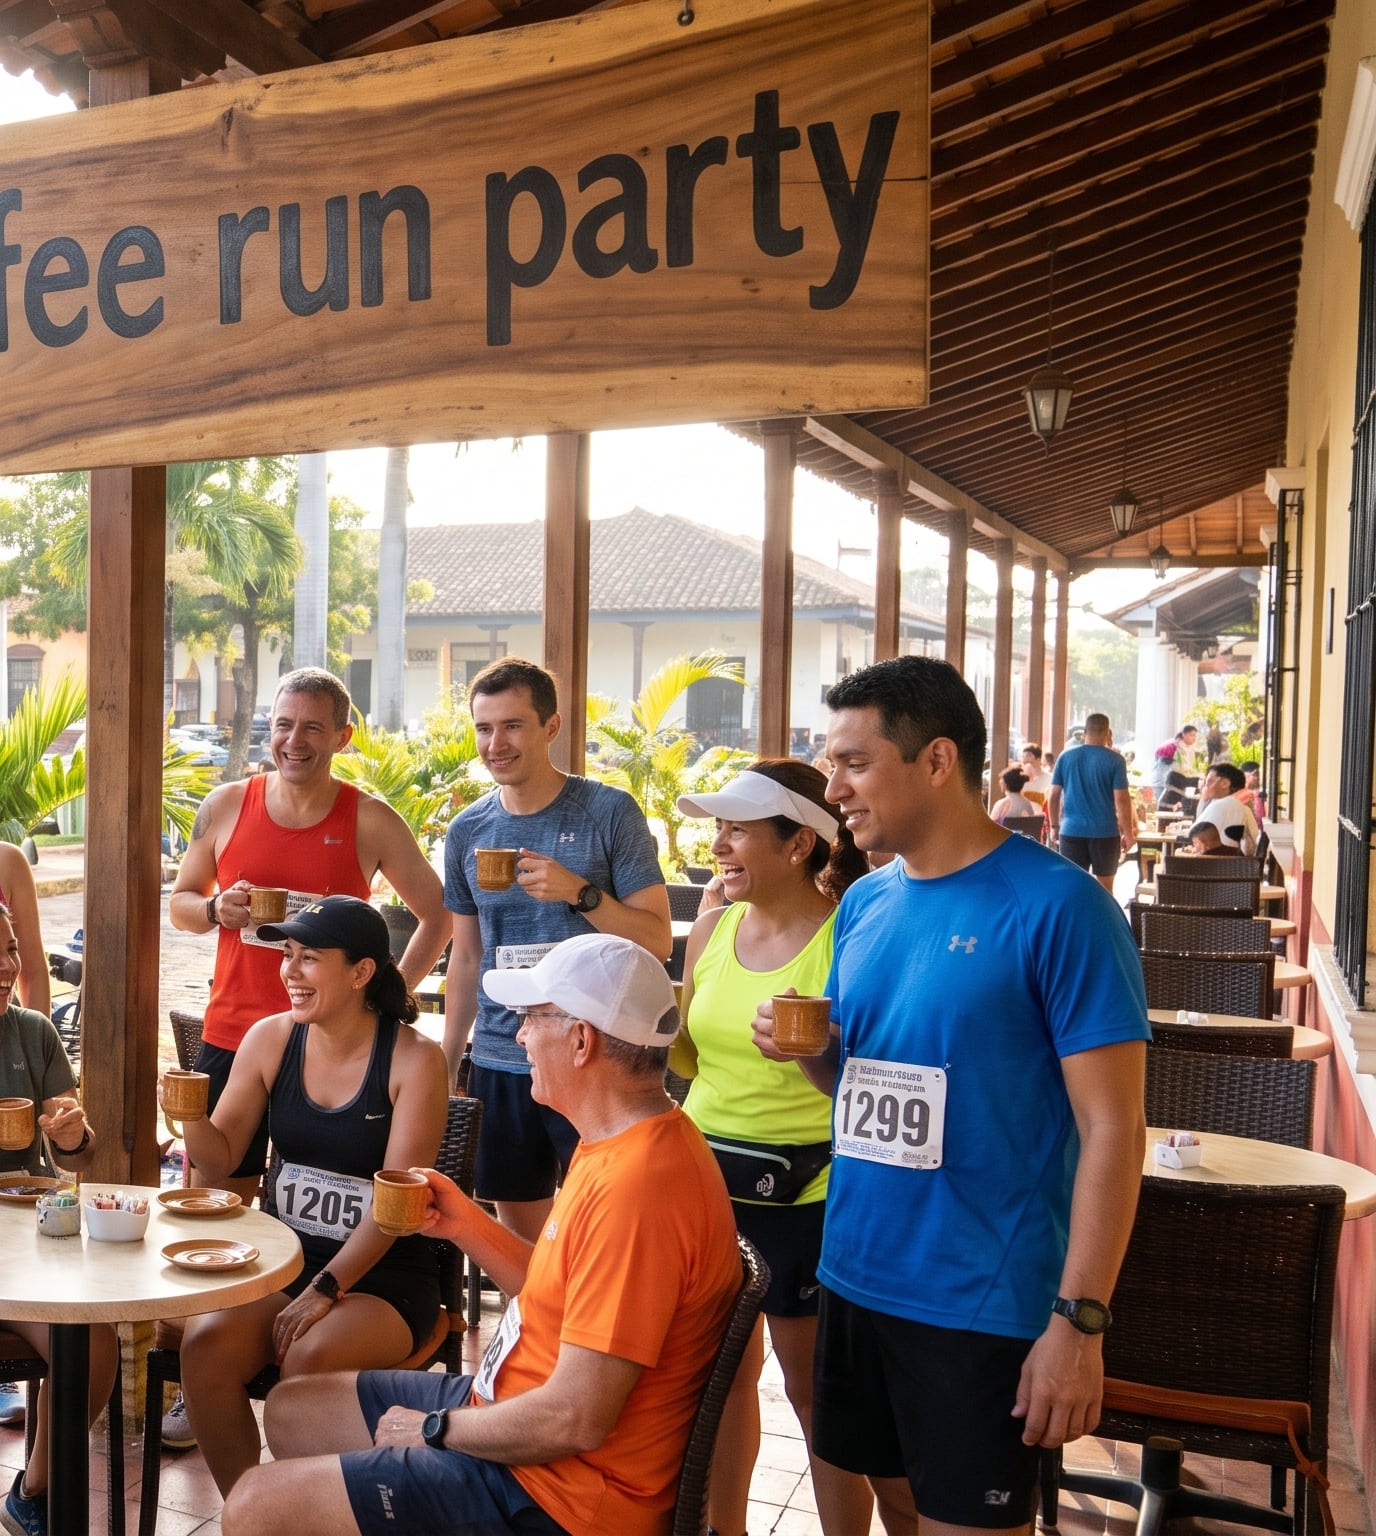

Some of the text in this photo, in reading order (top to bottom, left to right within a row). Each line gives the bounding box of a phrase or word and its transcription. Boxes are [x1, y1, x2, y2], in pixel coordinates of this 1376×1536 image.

[218, 183, 431, 325] run
[486, 89, 900, 347] party
[842, 1088, 930, 1147] 1299
[282, 1182, 363, 1230] 1205
